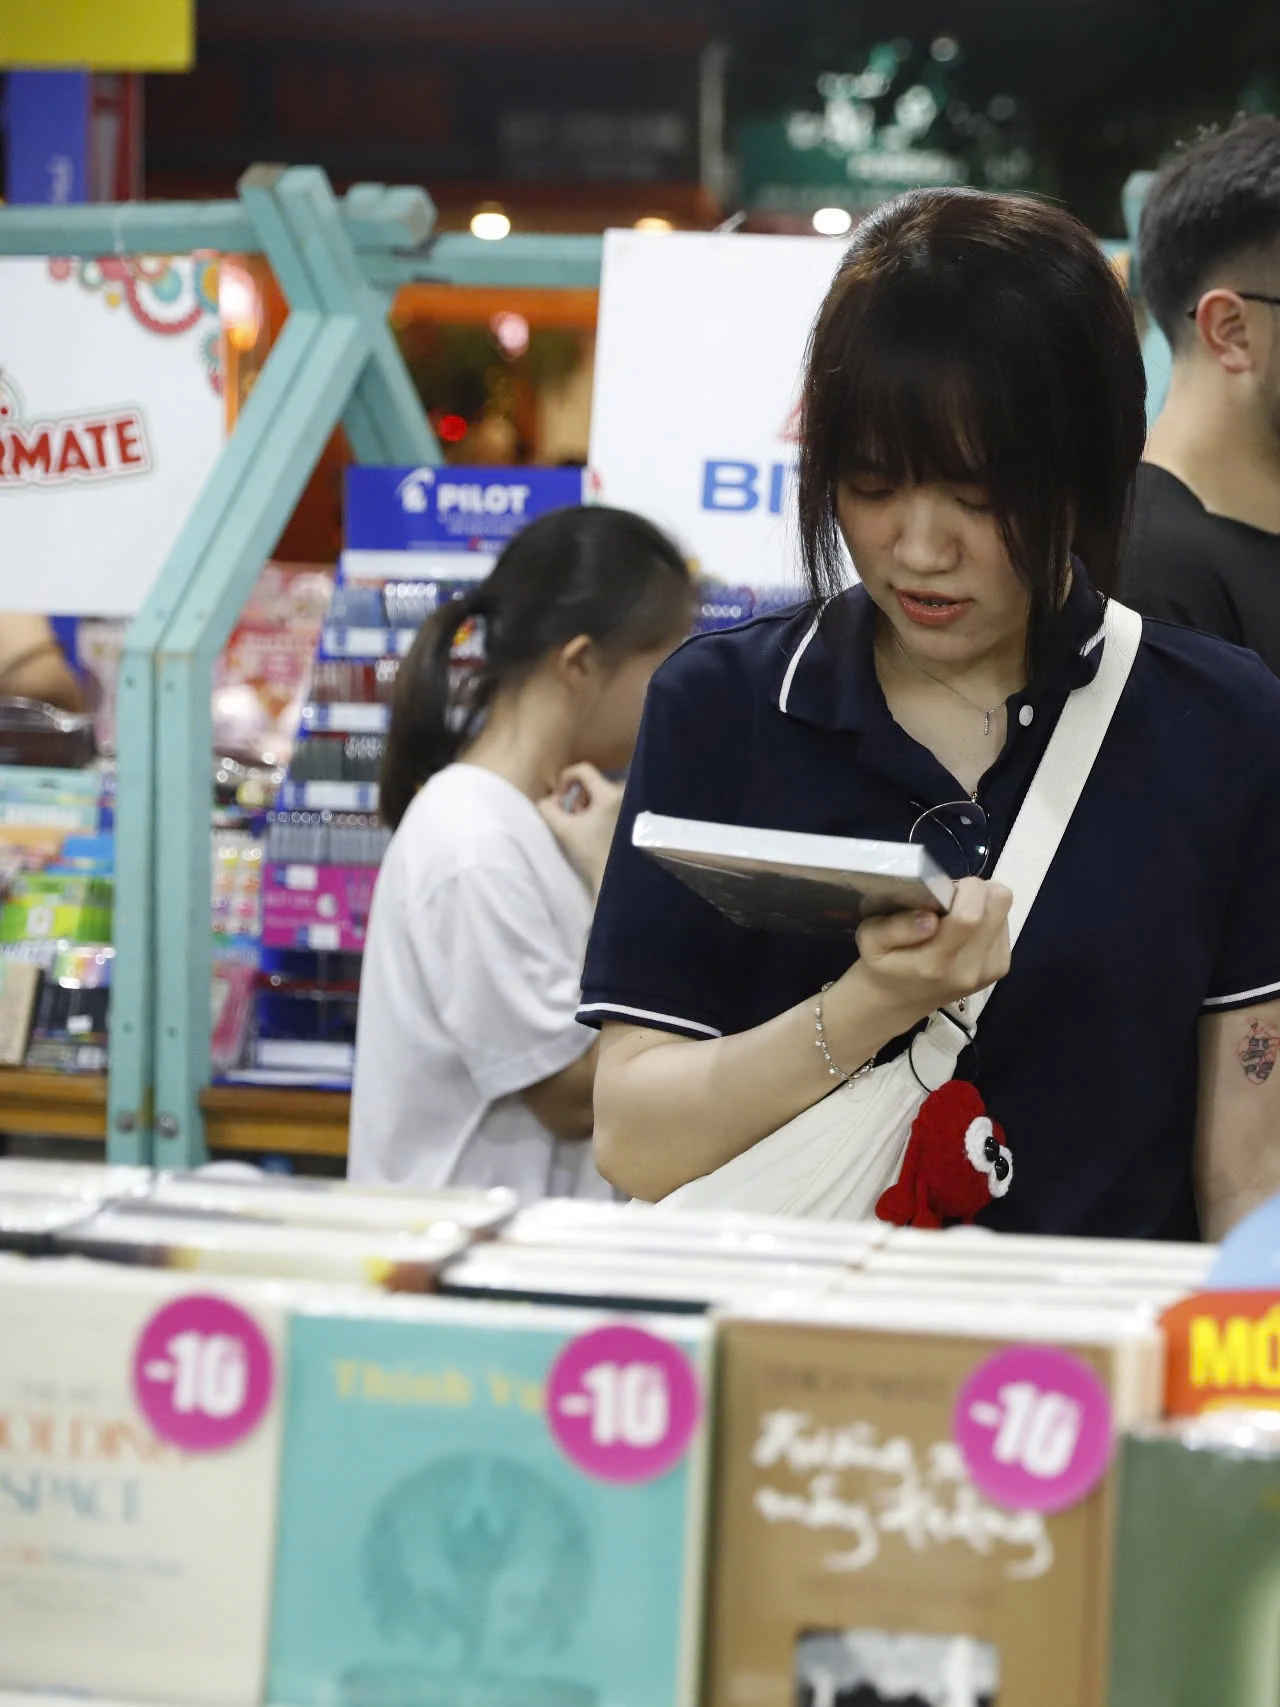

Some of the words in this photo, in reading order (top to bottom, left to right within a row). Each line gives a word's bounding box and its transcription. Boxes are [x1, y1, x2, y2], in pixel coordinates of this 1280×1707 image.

[0, 419, 141, 476] MATE
[436, 483, 531, 515] PILOT
[702, 459, 802, 515] BI
[144, 1333, 249, 1418] -10
[559, 1358, 670, 1448] -10
[968, 1380, 1083, 1480] -10
